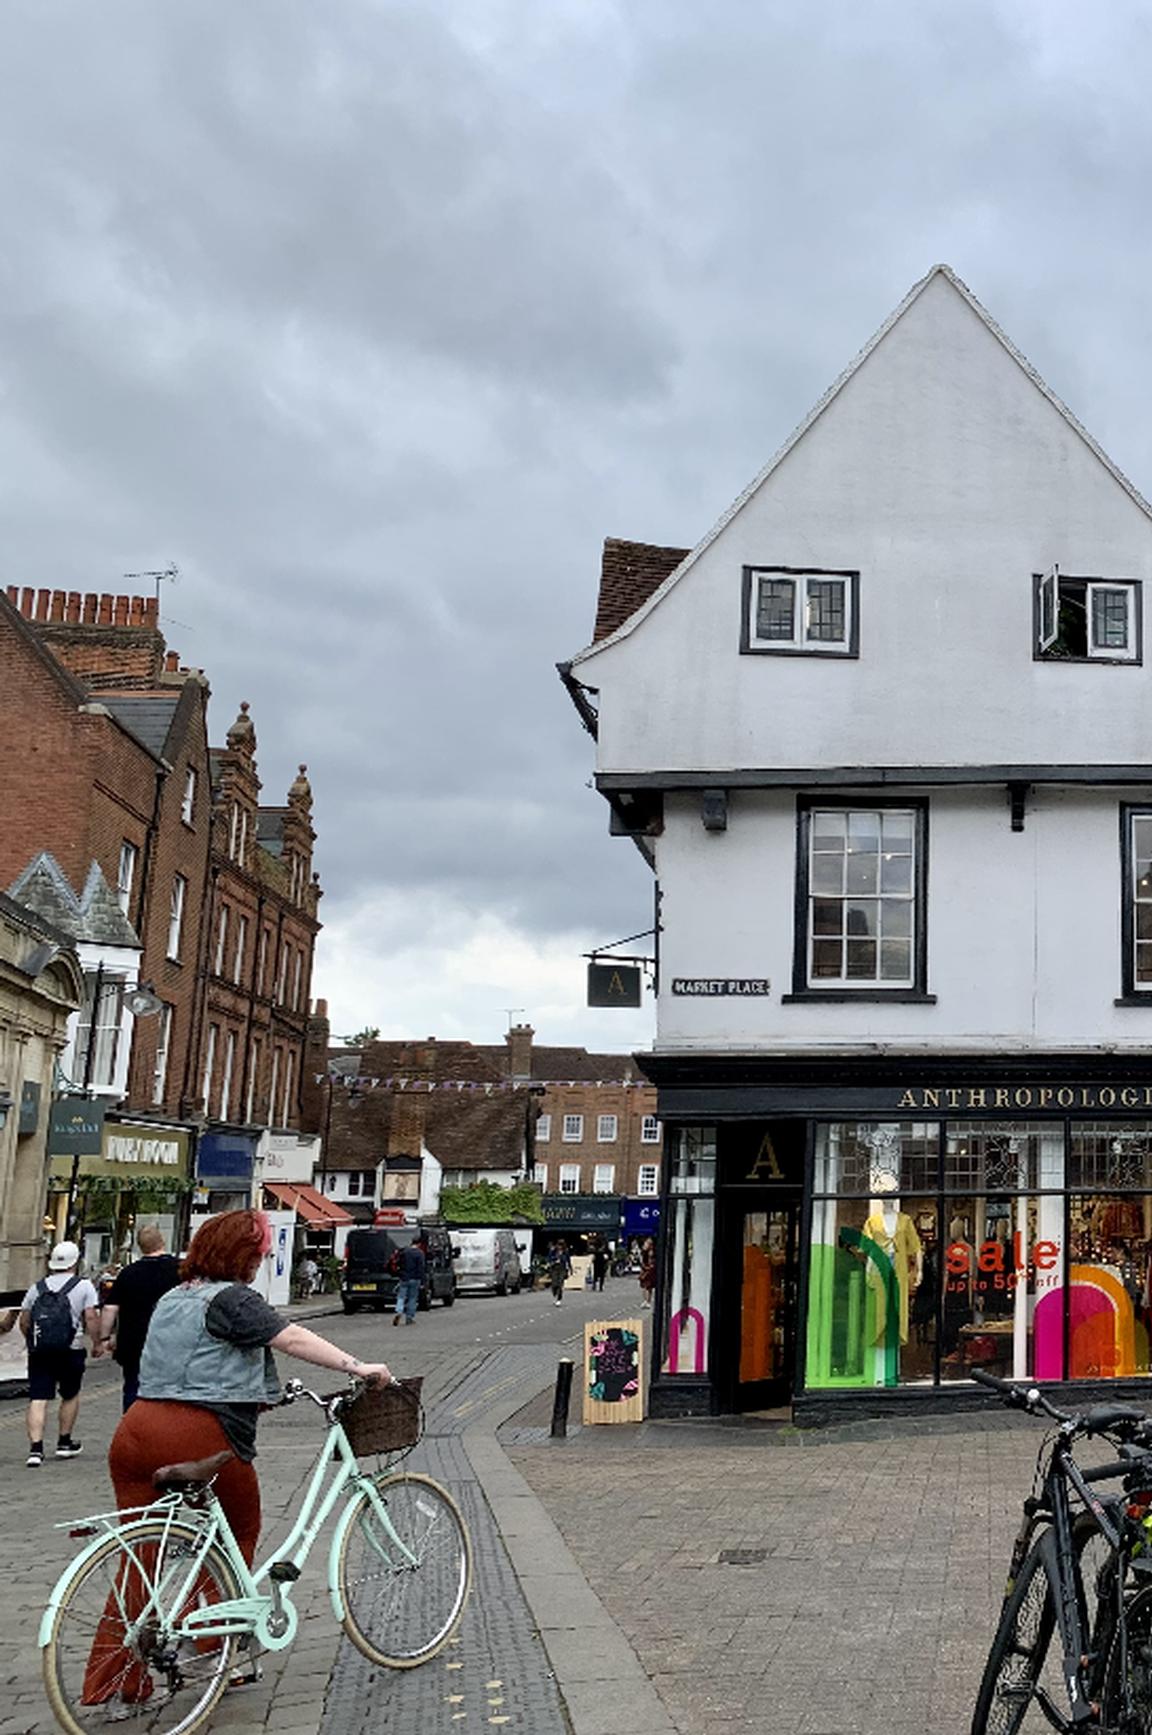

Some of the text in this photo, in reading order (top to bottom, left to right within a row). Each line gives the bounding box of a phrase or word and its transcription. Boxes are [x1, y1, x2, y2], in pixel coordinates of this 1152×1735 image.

[608, 971, 625, 994] A
[675, 981, 767, 994] MARKET PLACE
[745, 1132, 785, 1179] A
[946, 1231, 1059, 1274] sale
[947, 1281, 966, 1293] up
[972, 1279, 988, 1291] to
[1035, 1275, 1059, 1287] off
